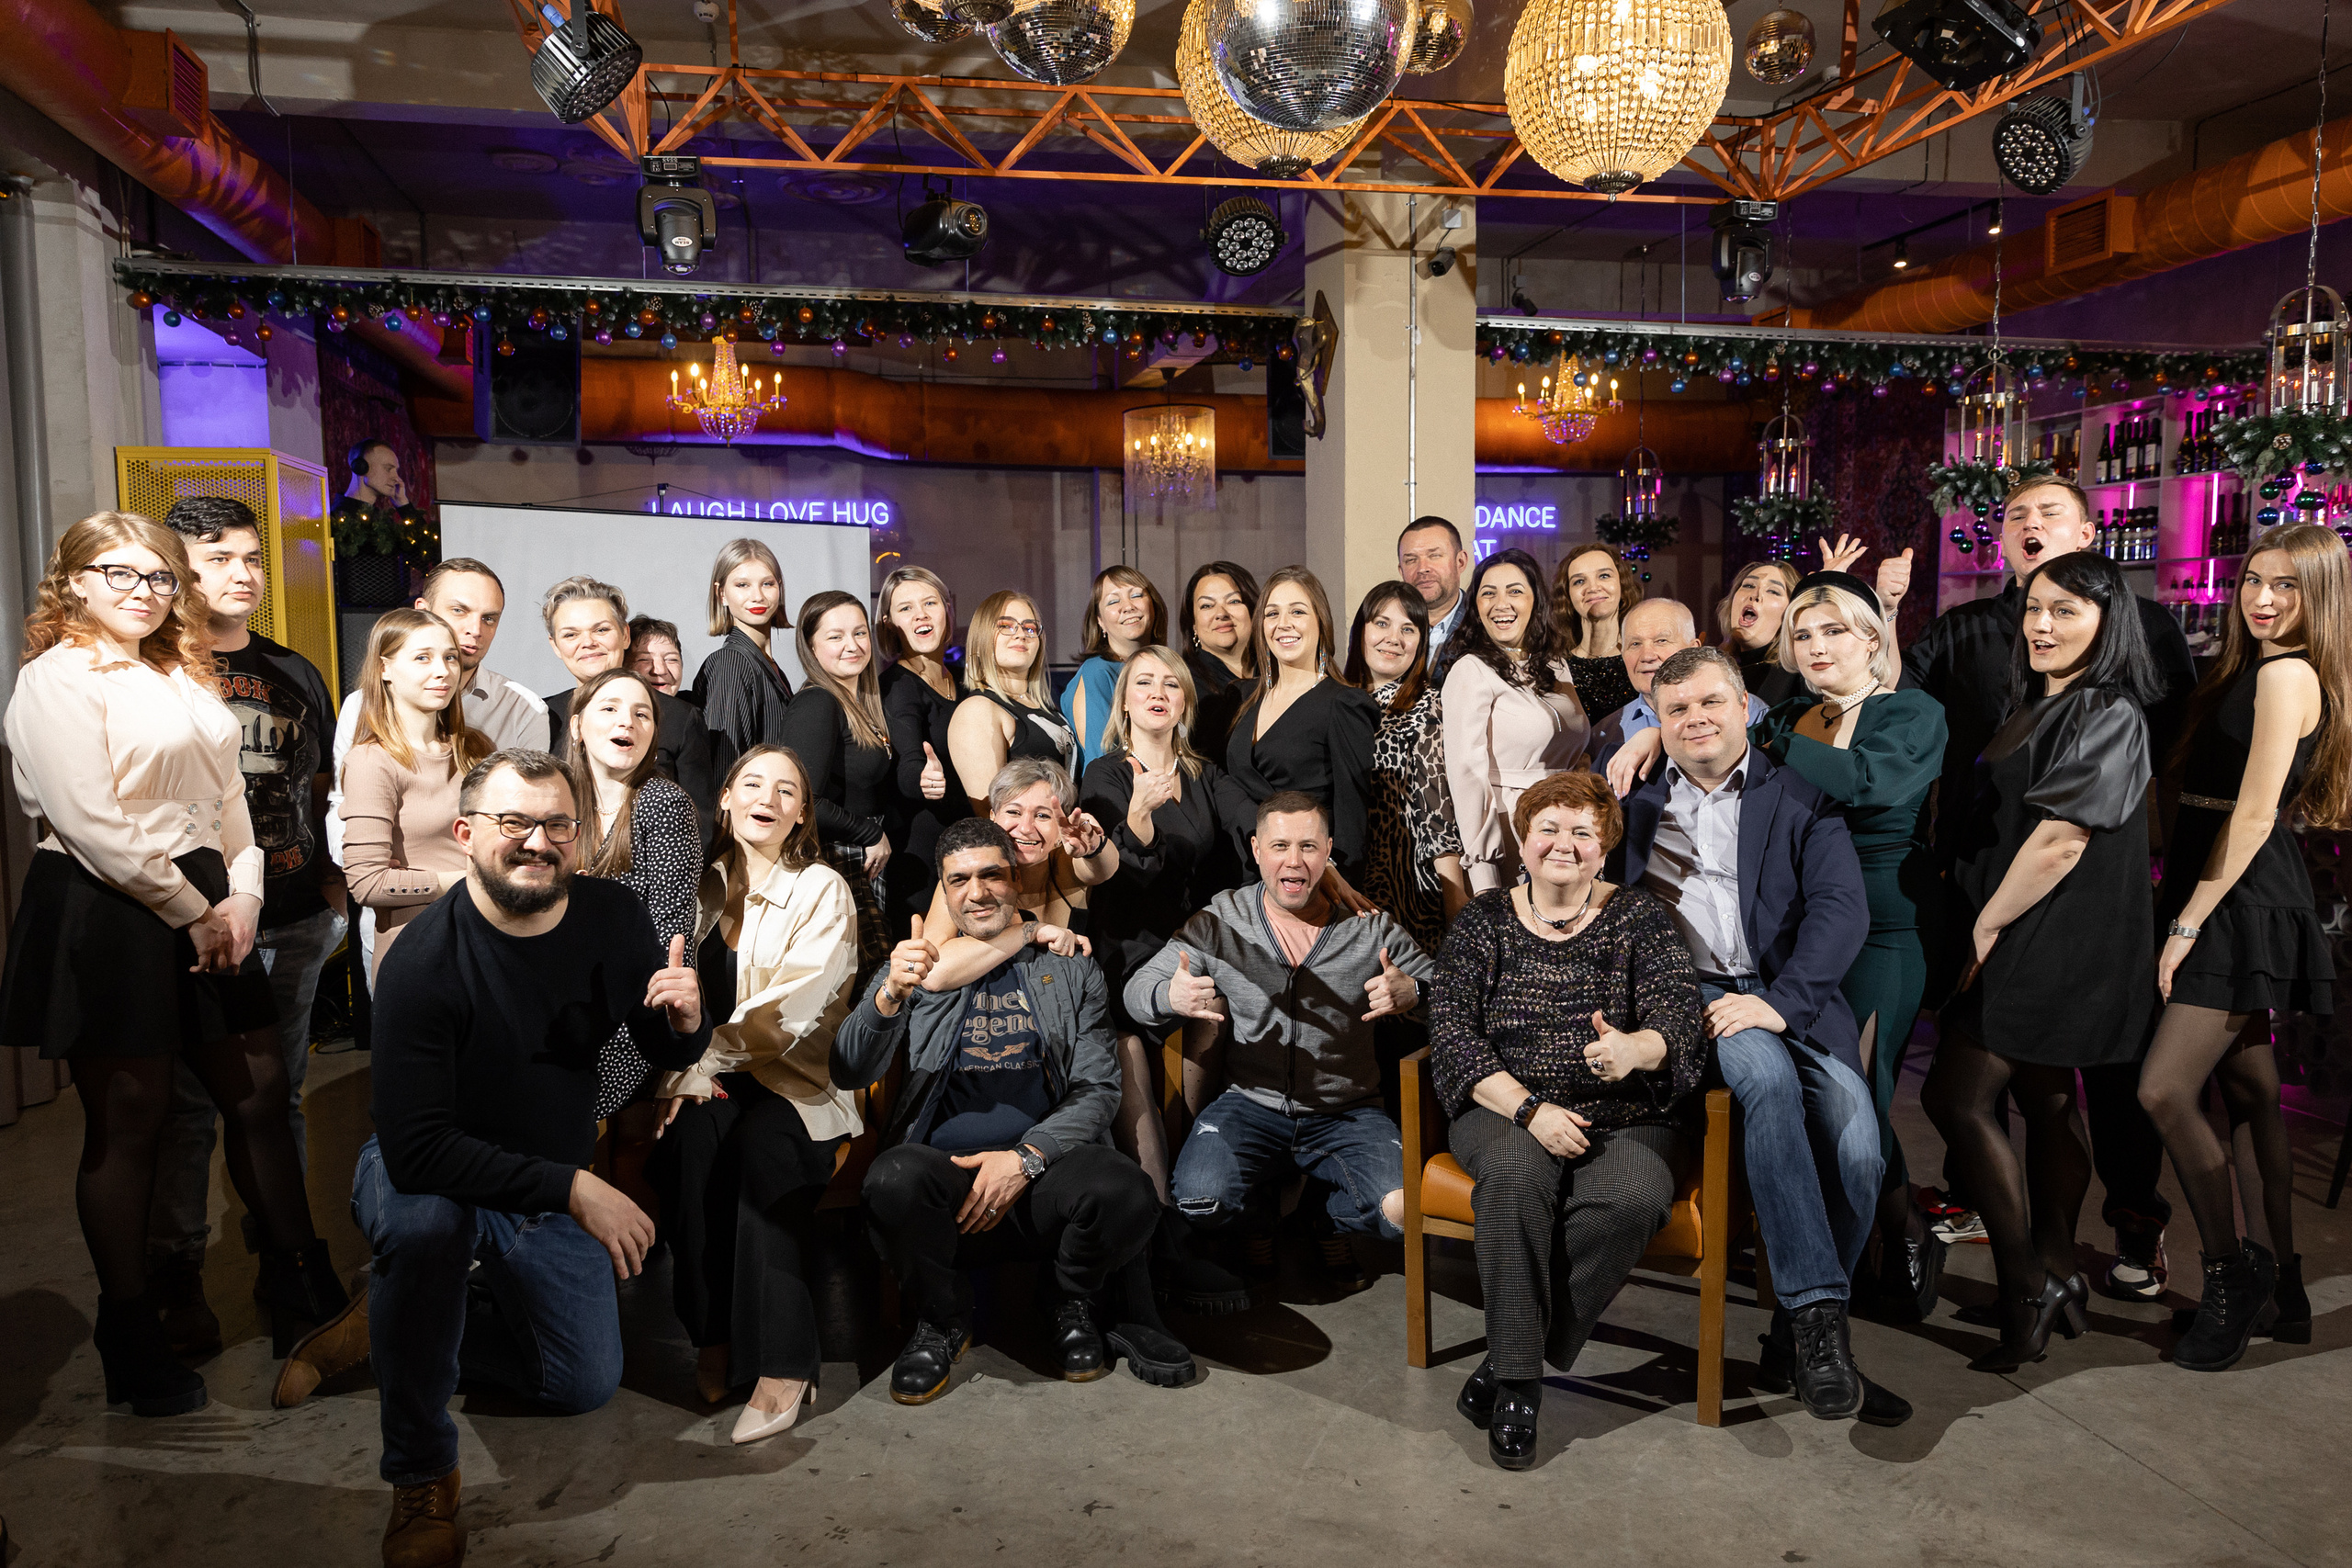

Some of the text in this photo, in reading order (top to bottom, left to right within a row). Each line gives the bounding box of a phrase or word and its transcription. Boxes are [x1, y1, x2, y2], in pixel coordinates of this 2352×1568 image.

[832, 502, 890, 525] HUG
[1475, 505, 1556, 529] DANCE
[958, 1059, 1040, 1073] AMERICAN CLASSIC
